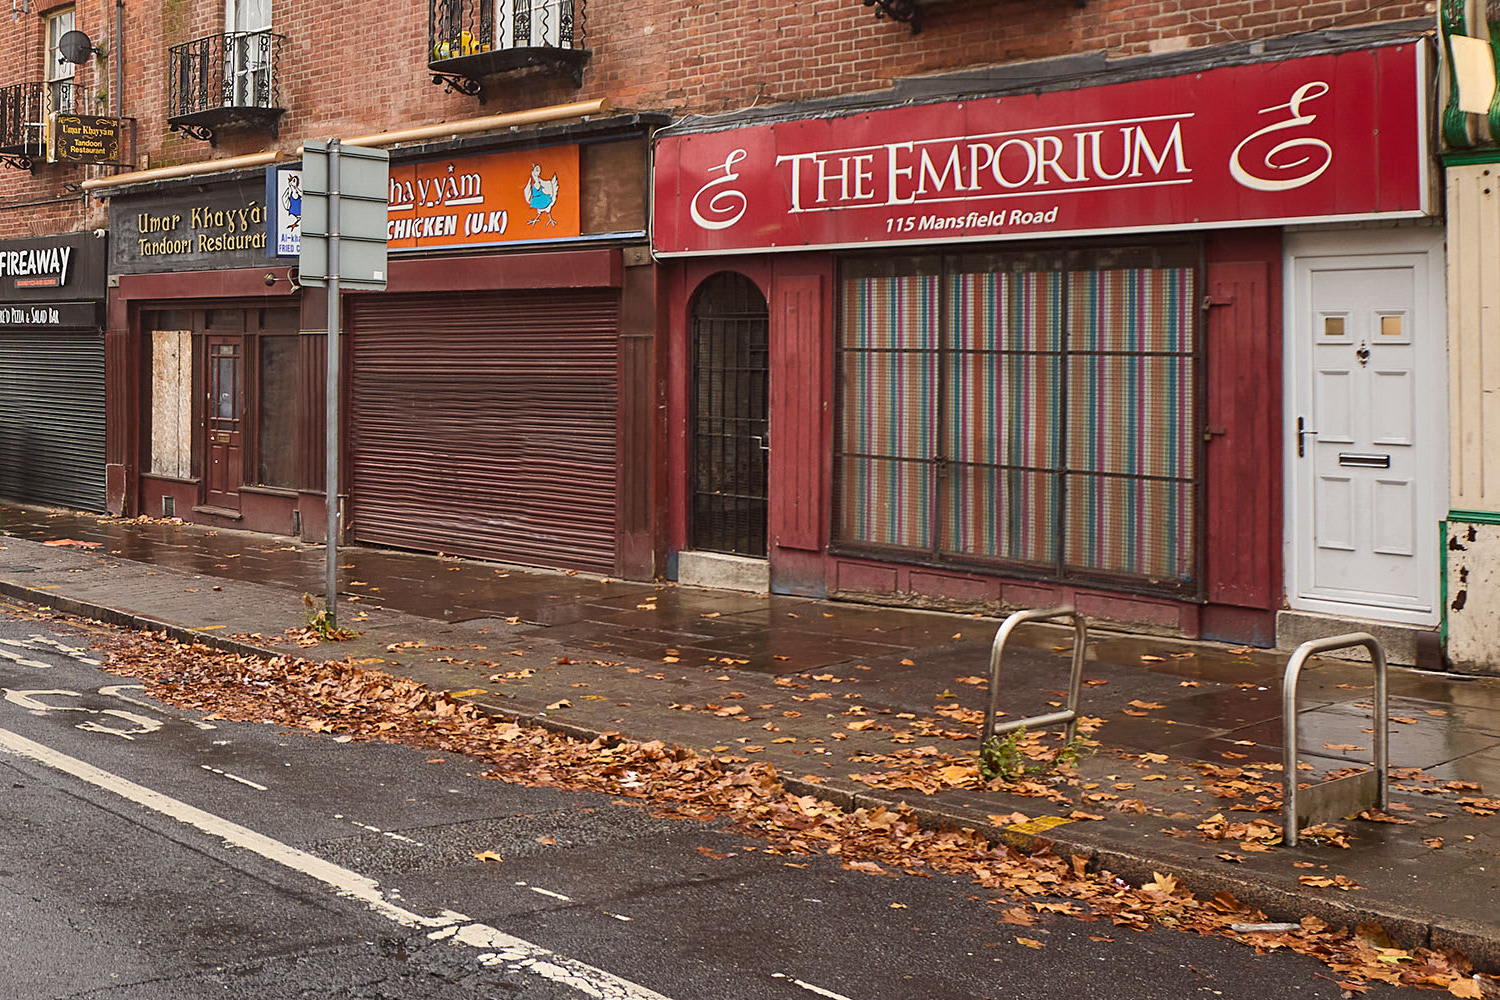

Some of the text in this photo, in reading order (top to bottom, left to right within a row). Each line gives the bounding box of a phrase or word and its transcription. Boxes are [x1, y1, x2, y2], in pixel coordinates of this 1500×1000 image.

[62, 124, 81, 135] Umar
[70, 145, 105, 154] Restaurant
[74, 138, 102, 147] Tandoori
[775, 121, 1193, 214] THE EMPORIUM
[138, 212, 181, 234] Umar
[388, 210, 509, 240] CHICKEN (U.K)
[886, 206, 1059, 233] 115 Mansfield Road
[137, 236, 192, 257] Tandoori
[279, 244, 295, 253] FRIED
[48, 307, 60, 324] BAR
